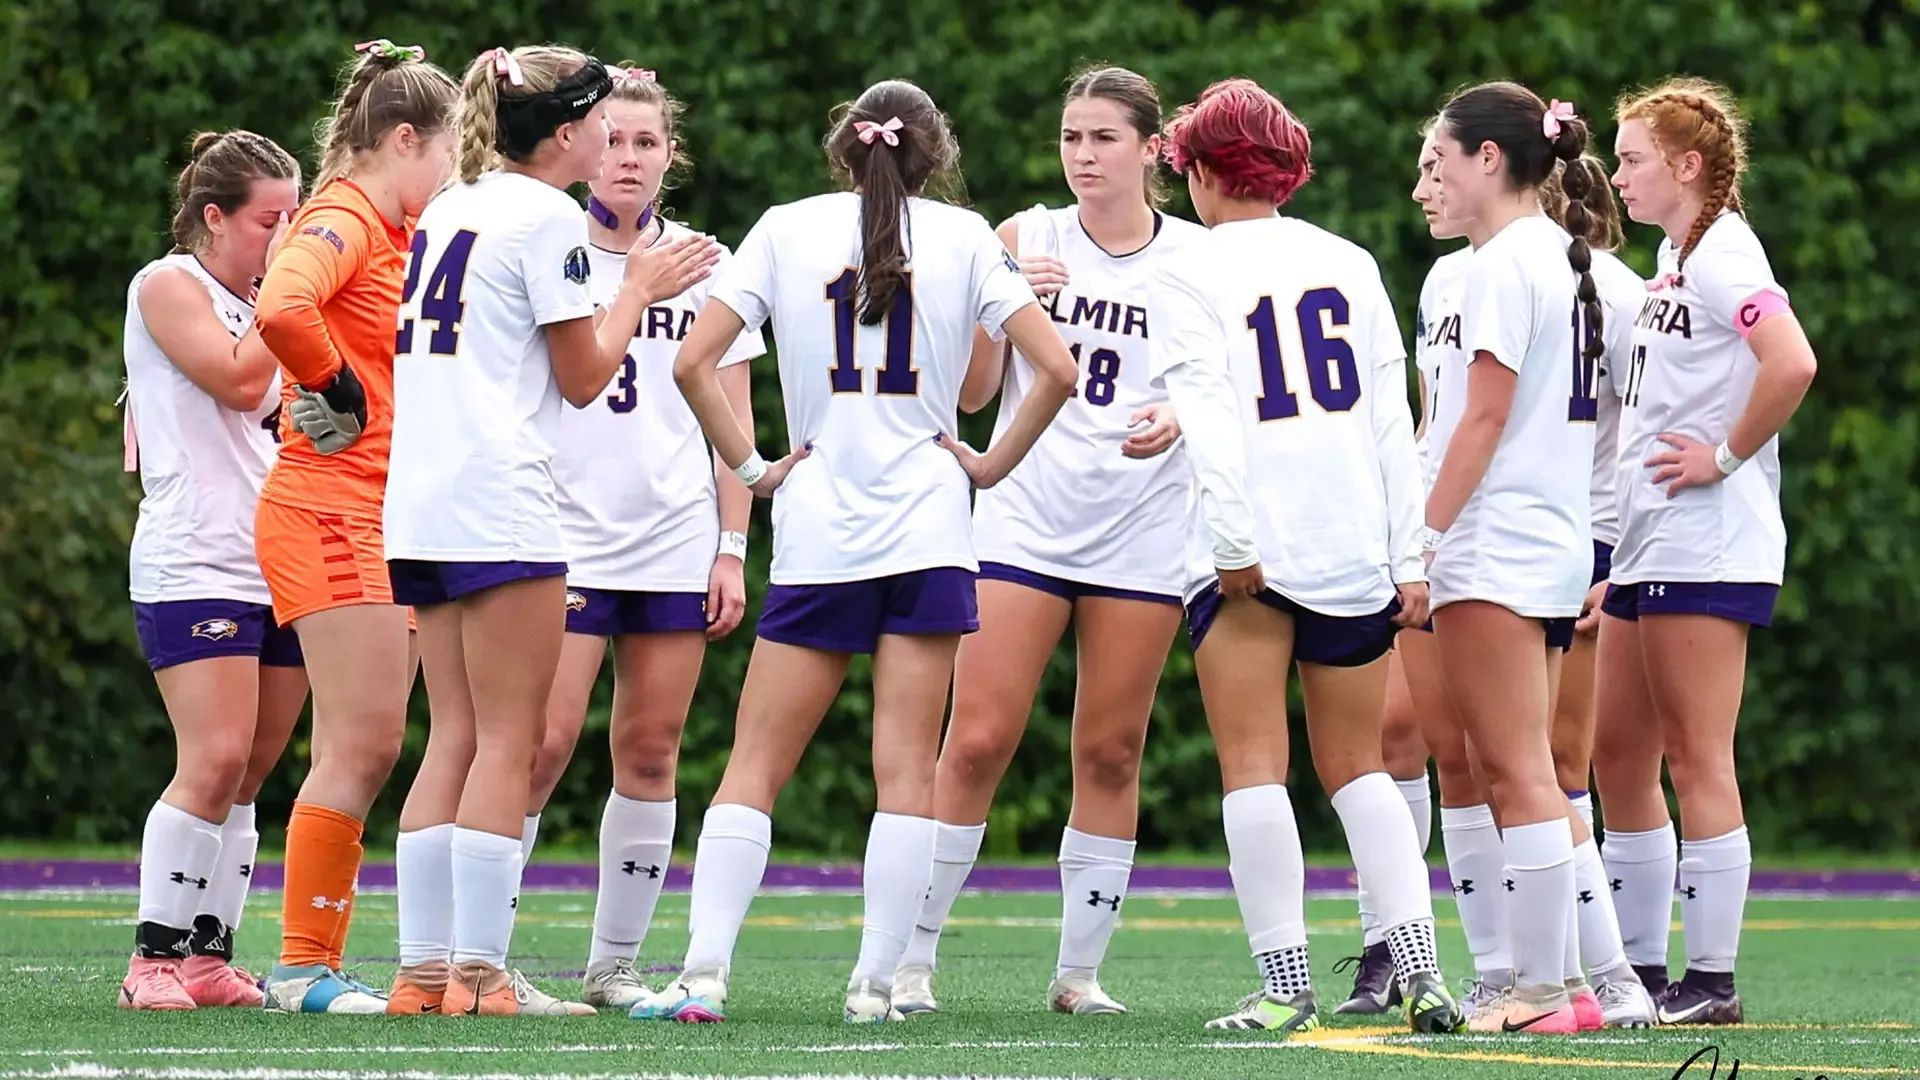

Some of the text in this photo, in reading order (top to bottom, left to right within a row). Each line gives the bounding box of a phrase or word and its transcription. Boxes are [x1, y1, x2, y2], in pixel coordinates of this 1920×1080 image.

[394, 226, 480, 357] 24
[823, 264, 920, 397] 11
[1245, 285, 1362, 423] 16
[1740, 303, 1761, 328] C
[607, 352, 638, 415] 3
